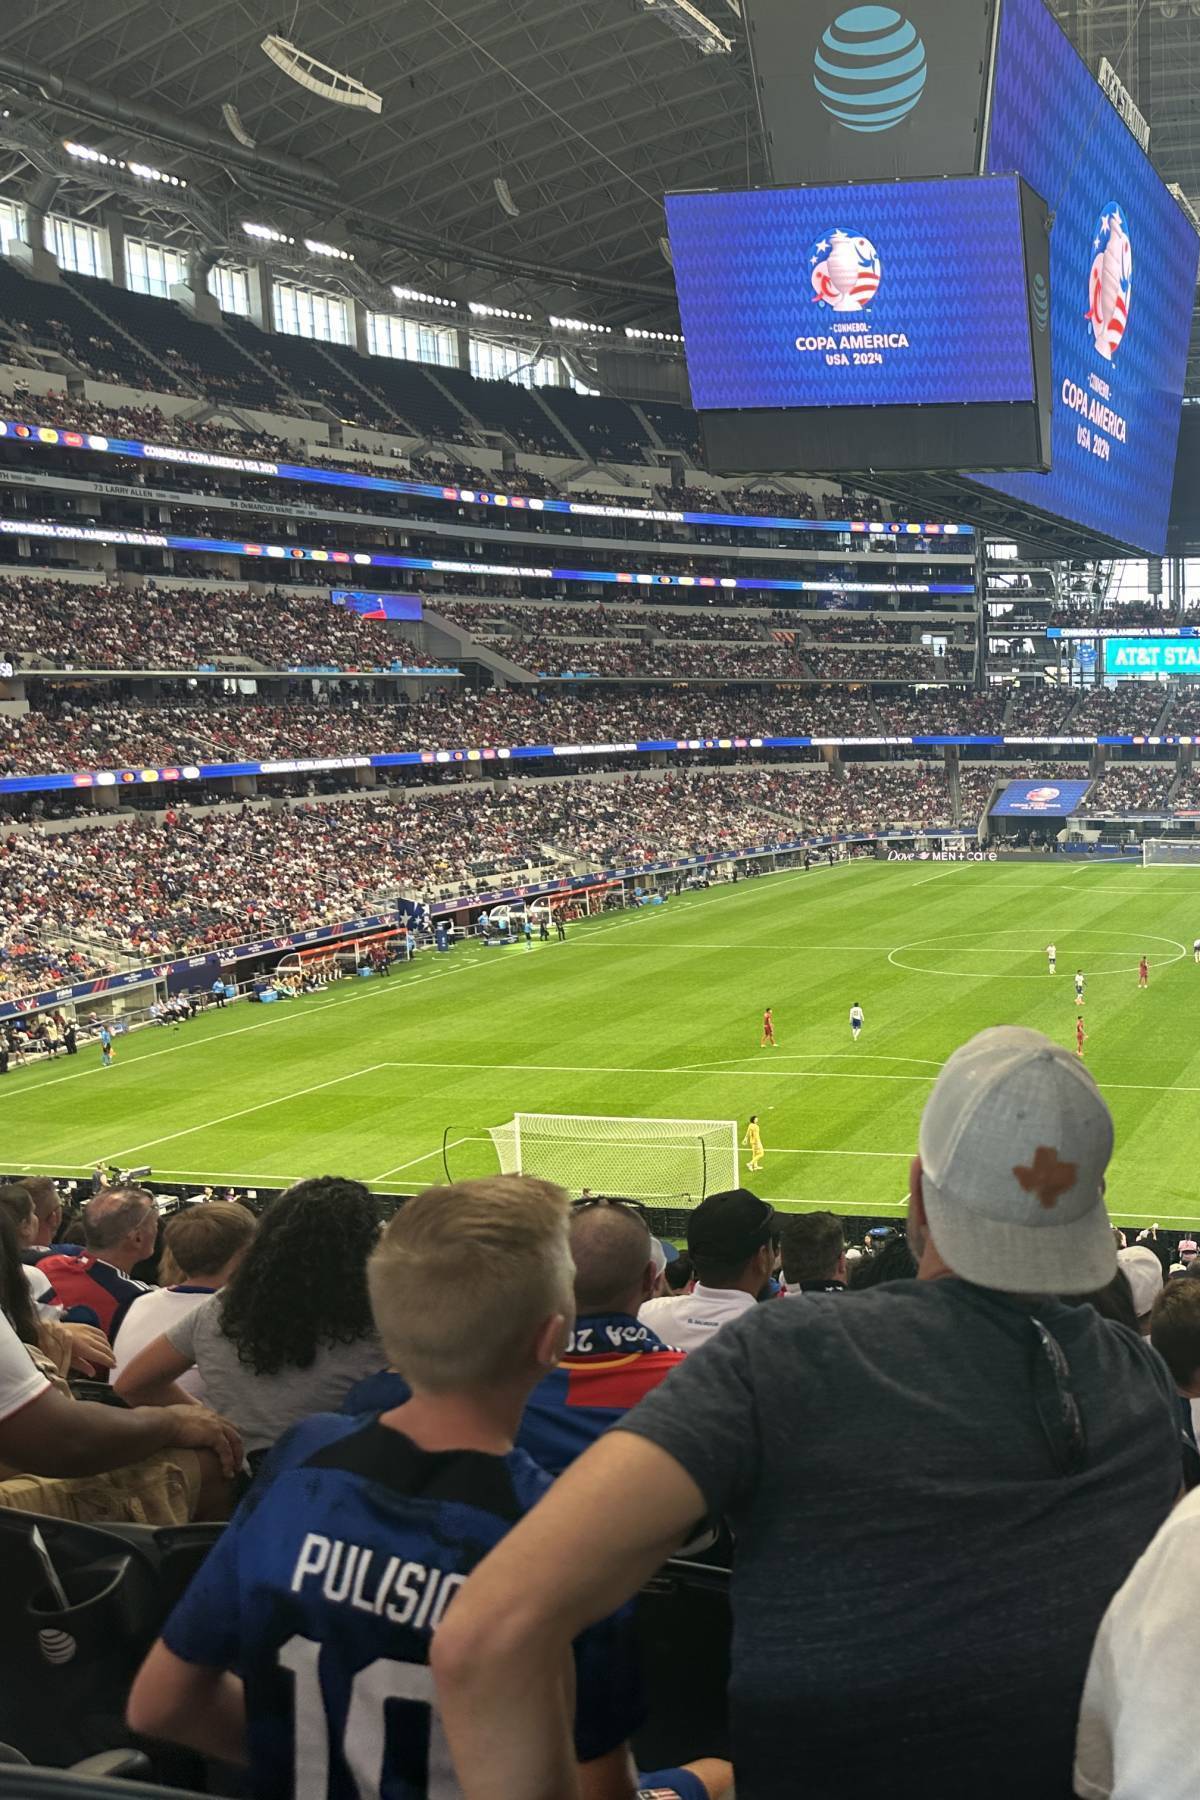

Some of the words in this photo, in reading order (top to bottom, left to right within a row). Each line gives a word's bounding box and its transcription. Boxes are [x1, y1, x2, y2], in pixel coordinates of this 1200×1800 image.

[796, 336, 837, 350] COPA
[840, 334, 910, 350] AMERICA
[826, 354, 850, 366] USA
[852, 352, 882, 364] 2024
[1062, 378, 1088, 418] COPA
[1088, 398, 1126, 444] AMERICA
[1077, 424, 1090, 452] USA
[1092, 434, 1110, 462] 2024
[94, 484, 104, 492] 73
[106, 485, 129, 495] LARRY
[130, 488, 153, 498] ALLEN
[276, 506, 293, 515] WARE
[1, 521, 56, 537] CONMEBOL
[56, 526, 82, 539] COPA
[83, 529, 125, 543] AMERICA
[1114, 648, 1160, 666] AT&T
[888, 850, 914, 860] Dove
[932, 852, 956, 860] MEN
[966, 852, 998, 861] care
